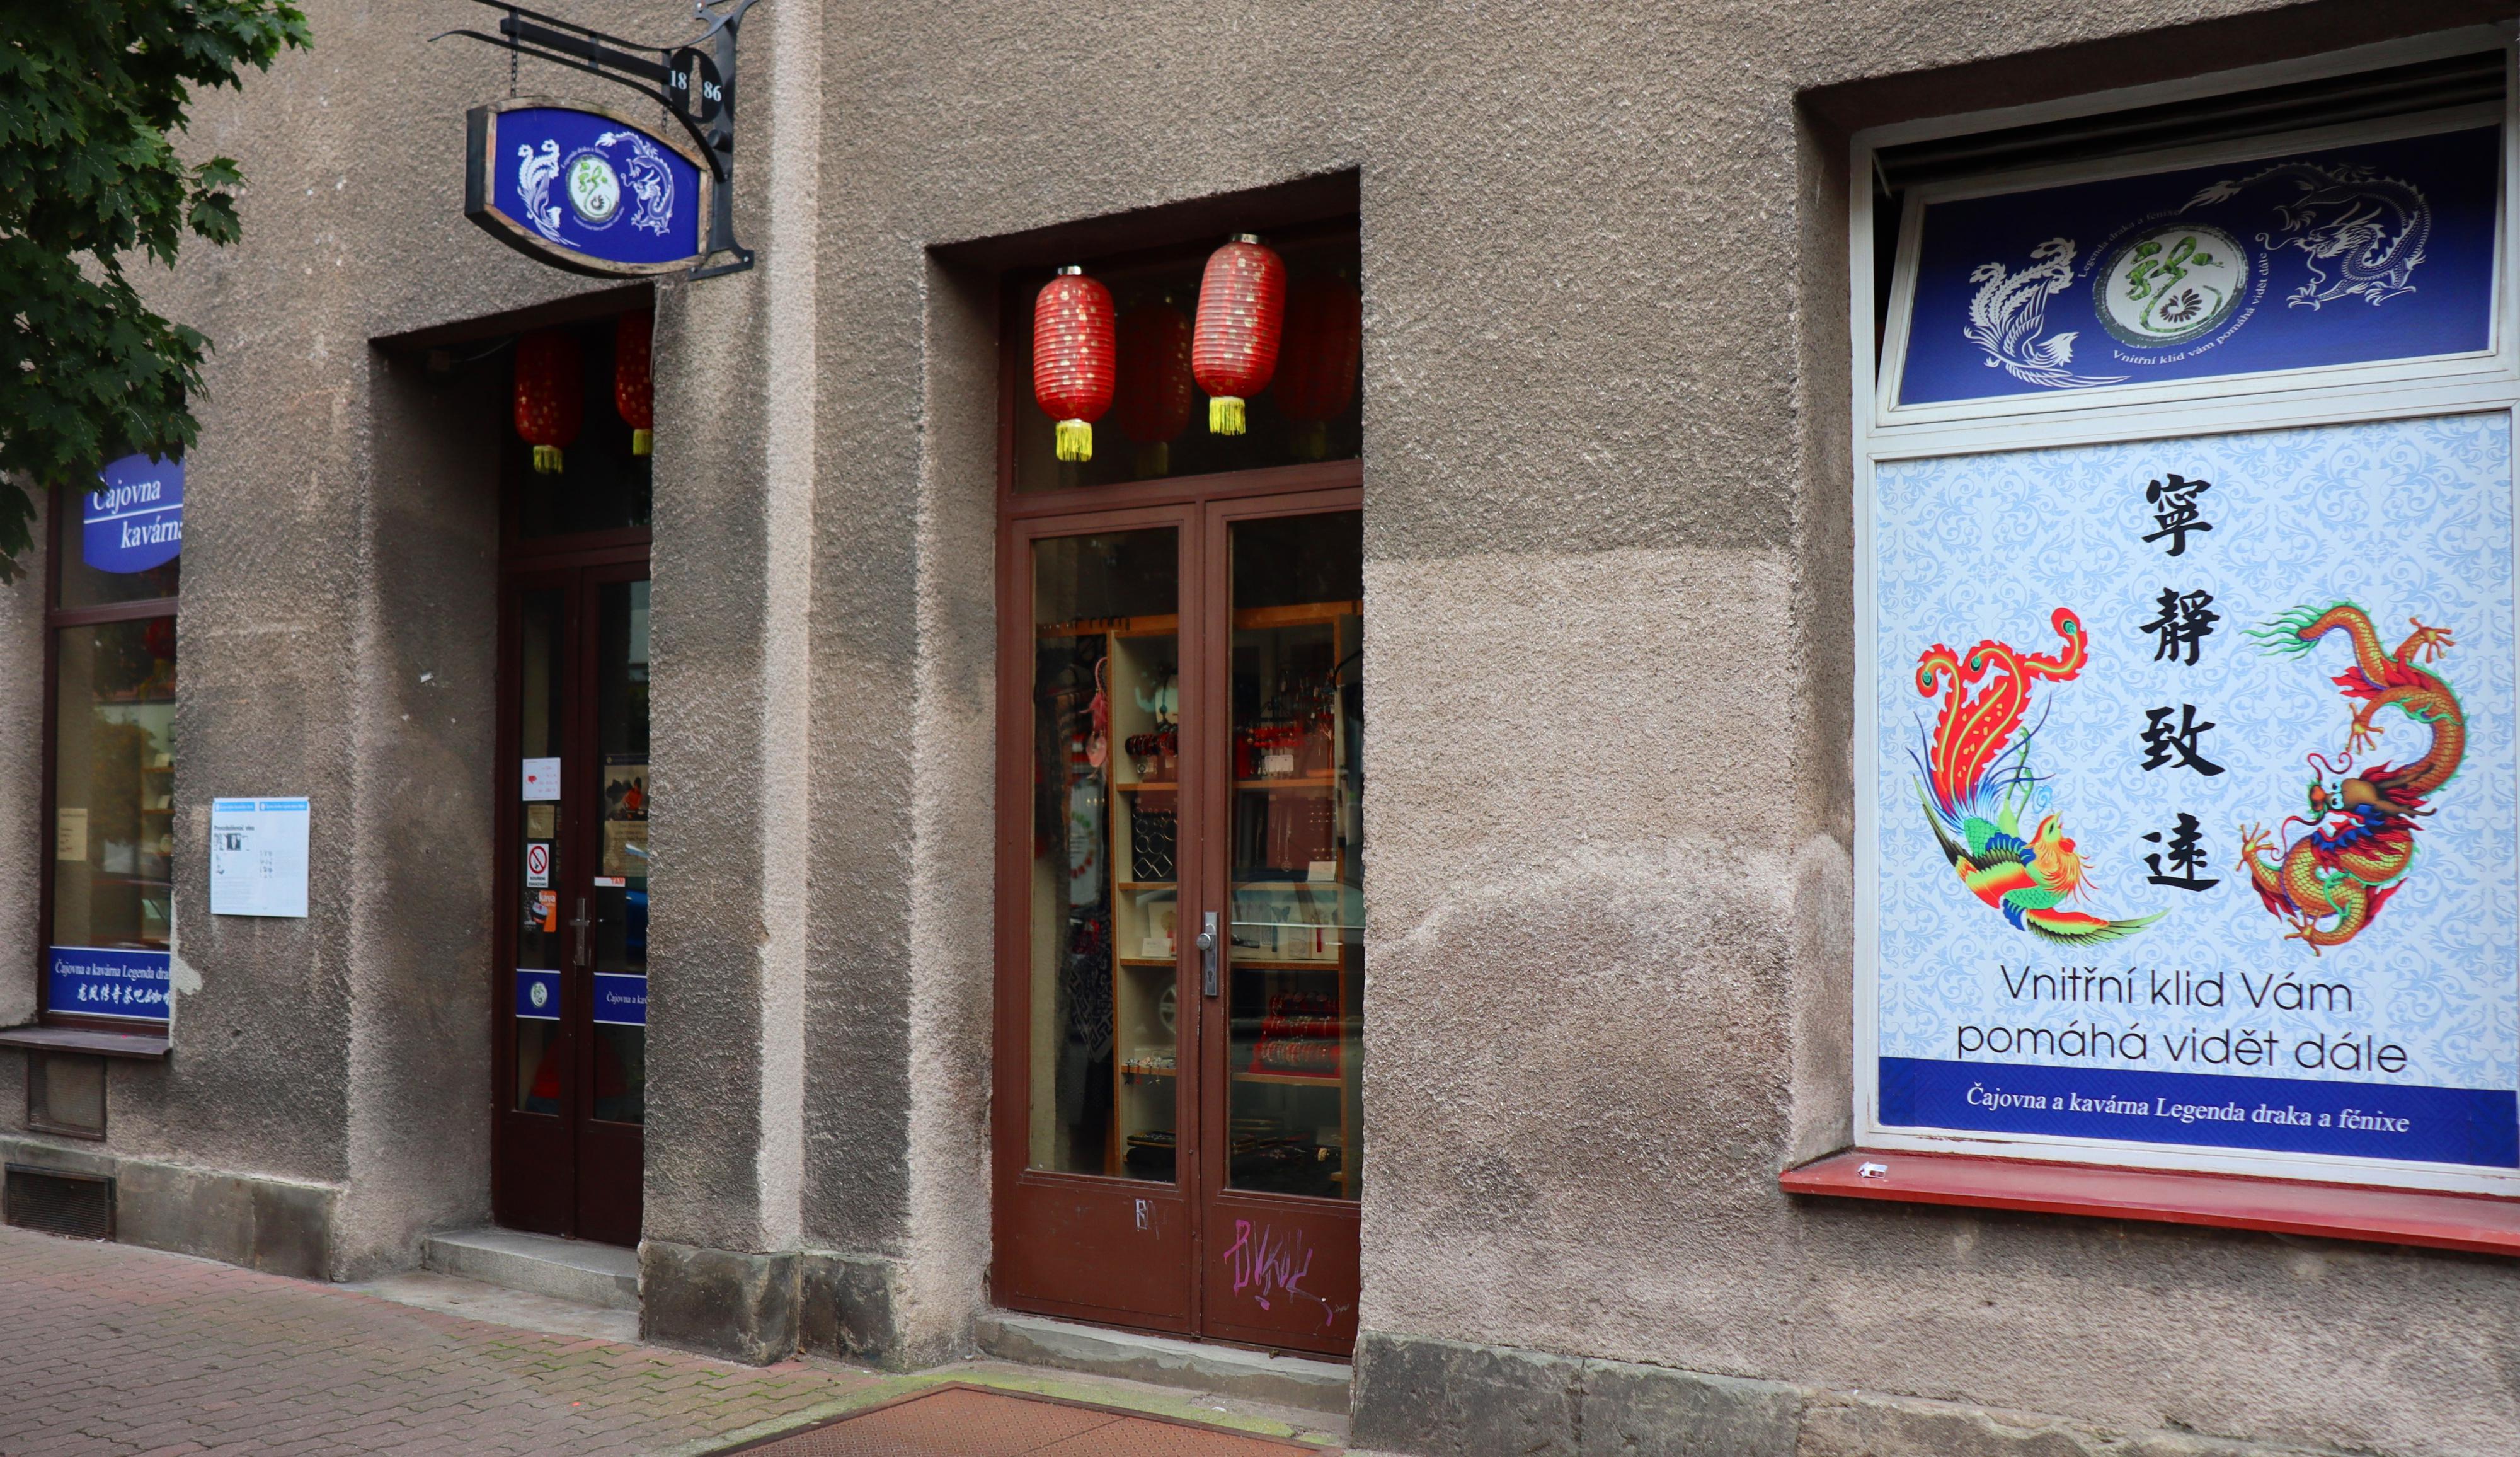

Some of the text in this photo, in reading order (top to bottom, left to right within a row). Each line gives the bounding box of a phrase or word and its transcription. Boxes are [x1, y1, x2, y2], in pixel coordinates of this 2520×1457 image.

[670, 70, 722, 101] 18 86
[2078, 241, 2109, 277] Legenda
[2109, 221, 2135, 241] draka
[2113, 252, 2269, 364] Vnitřní klid vám pomáhá vidět dále
[55, 958, 84, 977] Čajovna
[92, 962, 121, 977] kavárna
[122, 964, 154, 981] Legenda
[2000, 964, 2352, 1012] Vnitřní klid Vám
[1958, 1020, 2408, 1073] pomáhá vidět dále
[1966, 1082, 2410, 1133] Čajovna a kavárna Legenda draka a fénixe
